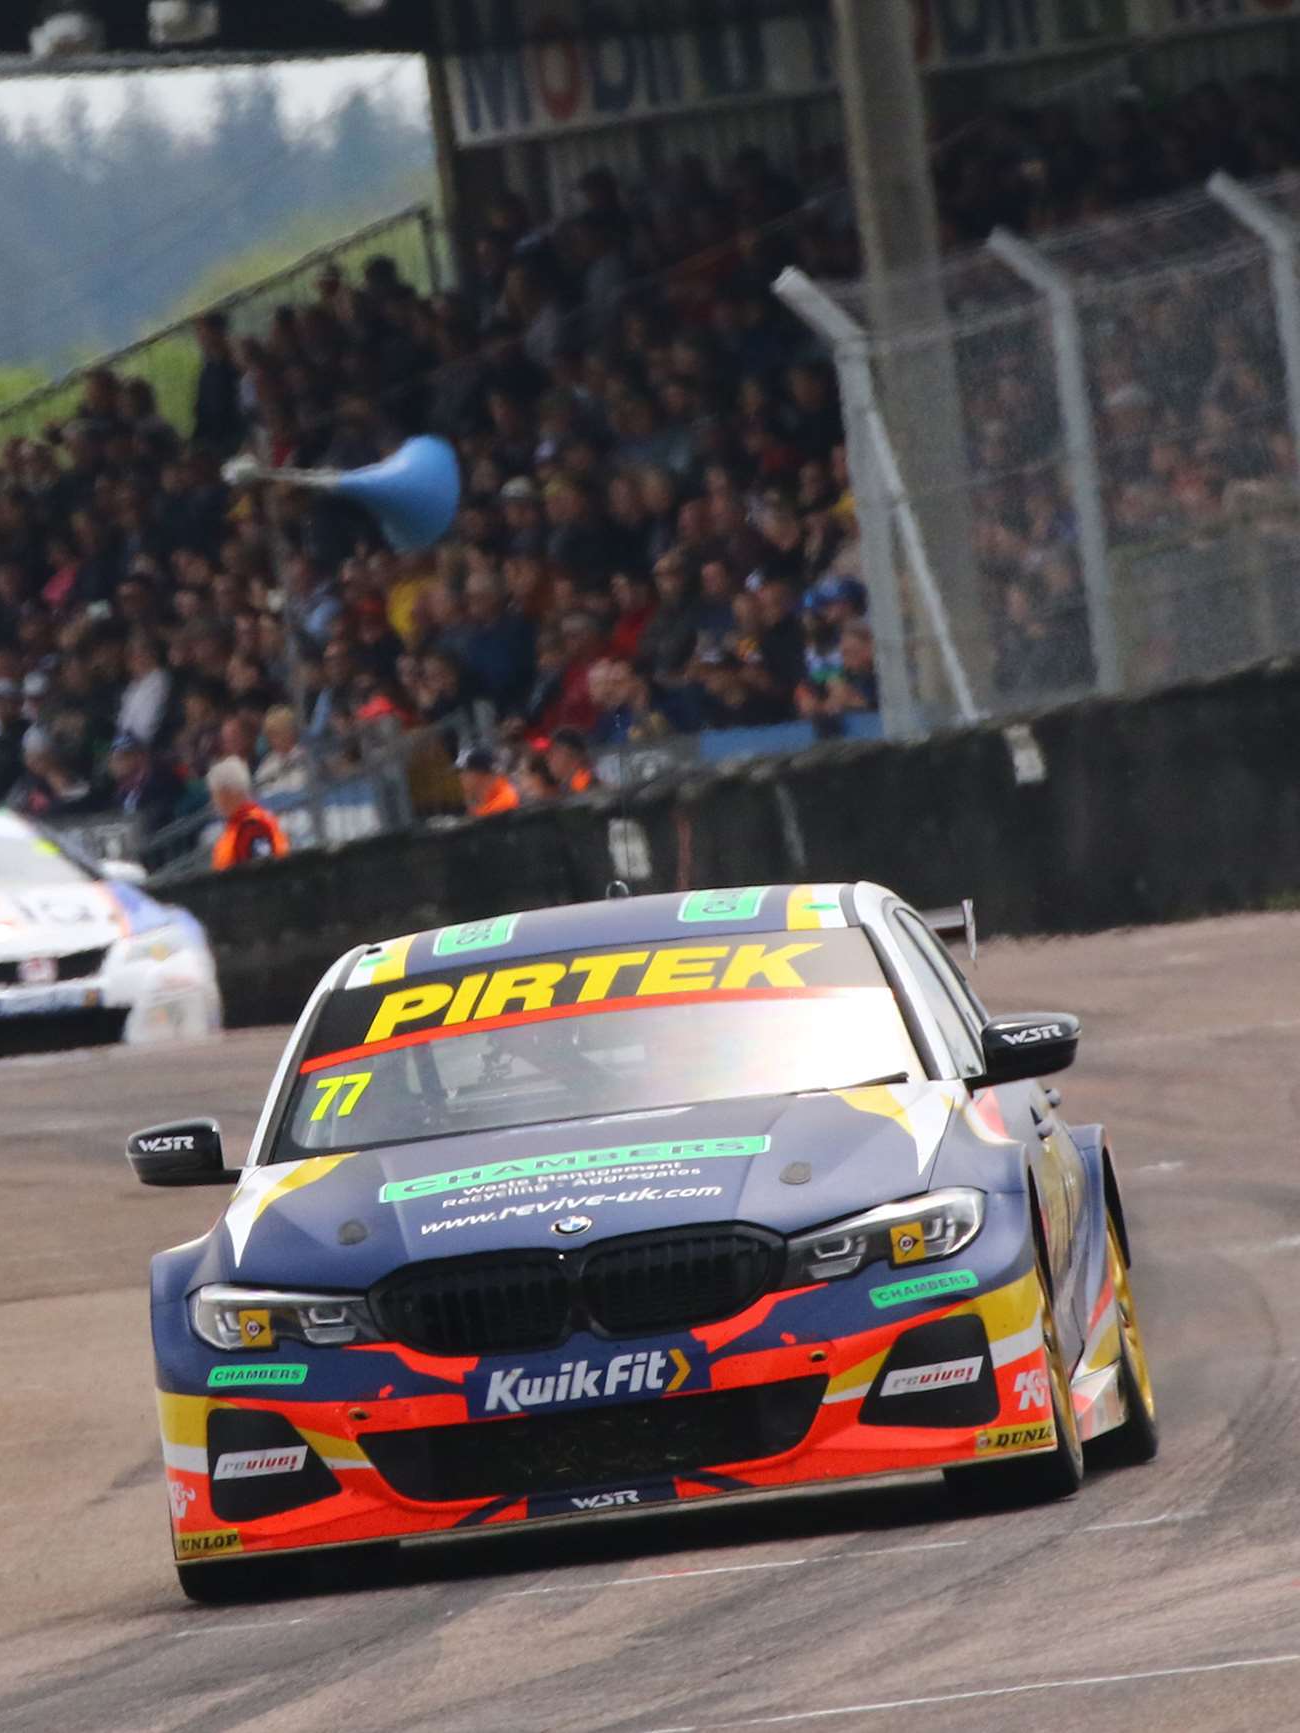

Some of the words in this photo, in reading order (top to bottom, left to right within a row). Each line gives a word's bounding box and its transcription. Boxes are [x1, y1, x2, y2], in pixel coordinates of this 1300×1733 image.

[363, 942, 823, 1044] PIRTEK
[1001, 1024, 1062, 1045] WSR
[310, 1072, 372, 1121] 77
[138, 1136, 195, 1152] WSR
[403, 1140, 747, 1195] CHAMBERS
[463, 1177, 529, 1196] Waste
[537, 1162, 683, 1184] Management
[420, 1185, 723, 1236] www.revive-uk.com
[877, 1275, 971, 1301] CHAMBERS
[214, 1369, 301, 1382] CHAMBERS
[996, 1424, 1054, 1447] DUNL
[571, 1489, 640, 1509] WSR
[179, 1534, 238, 1552] UNLOP
